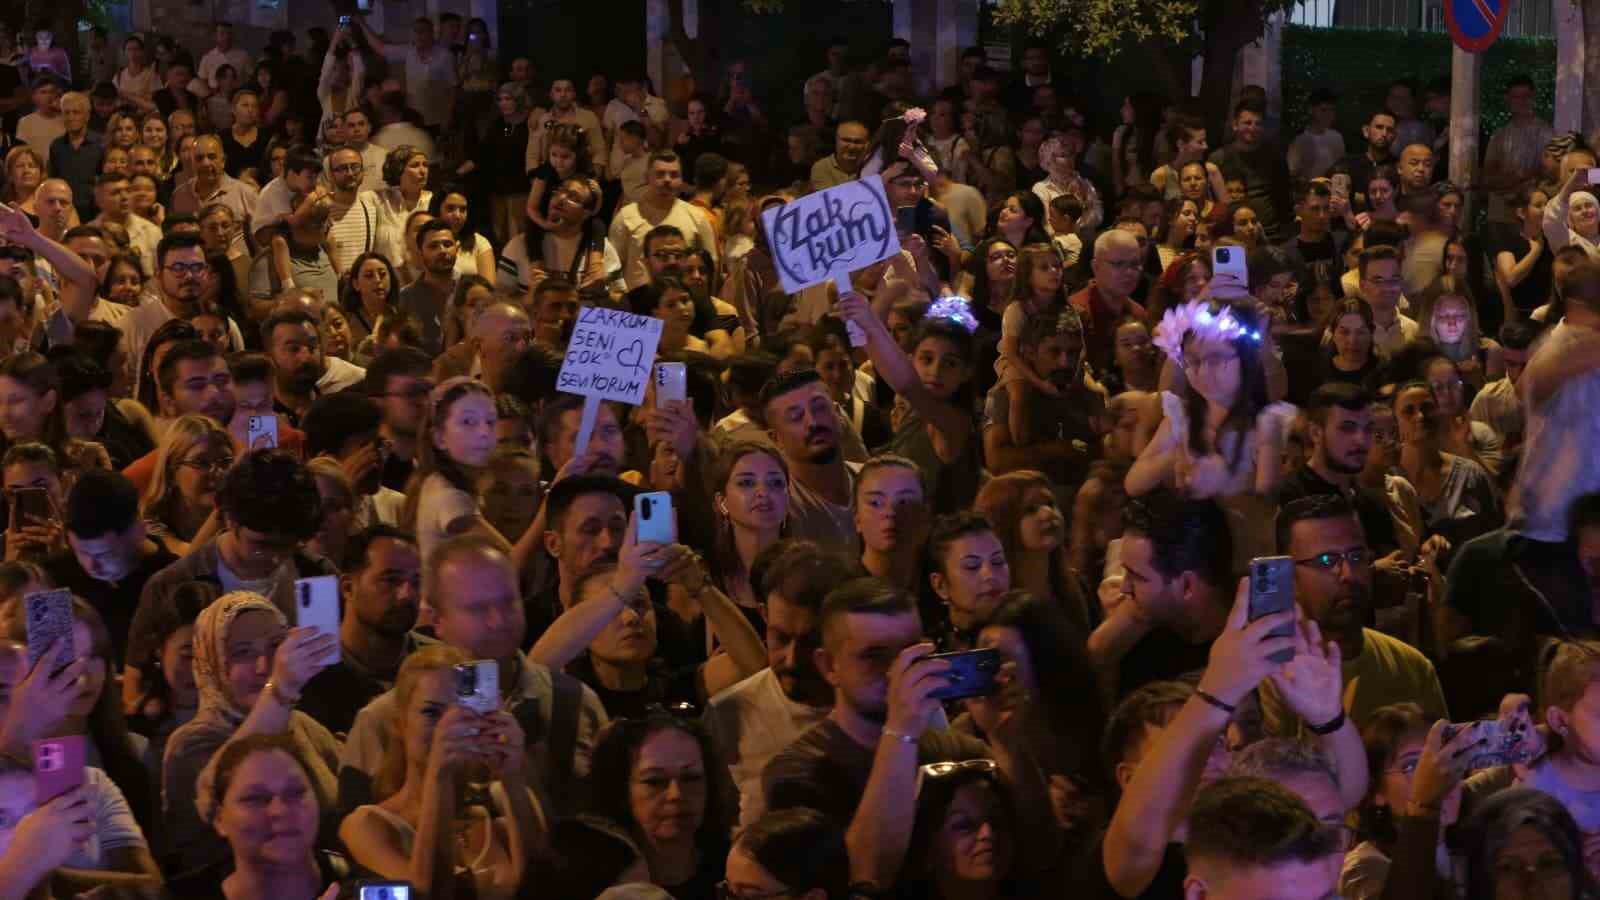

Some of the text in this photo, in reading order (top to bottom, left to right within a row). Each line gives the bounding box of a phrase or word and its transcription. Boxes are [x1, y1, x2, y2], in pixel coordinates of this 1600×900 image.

[780, 191, 845, 249] Zak
[807, 213, 886, 271] kum
[580, 307, 648, 329] ZAKKUM
